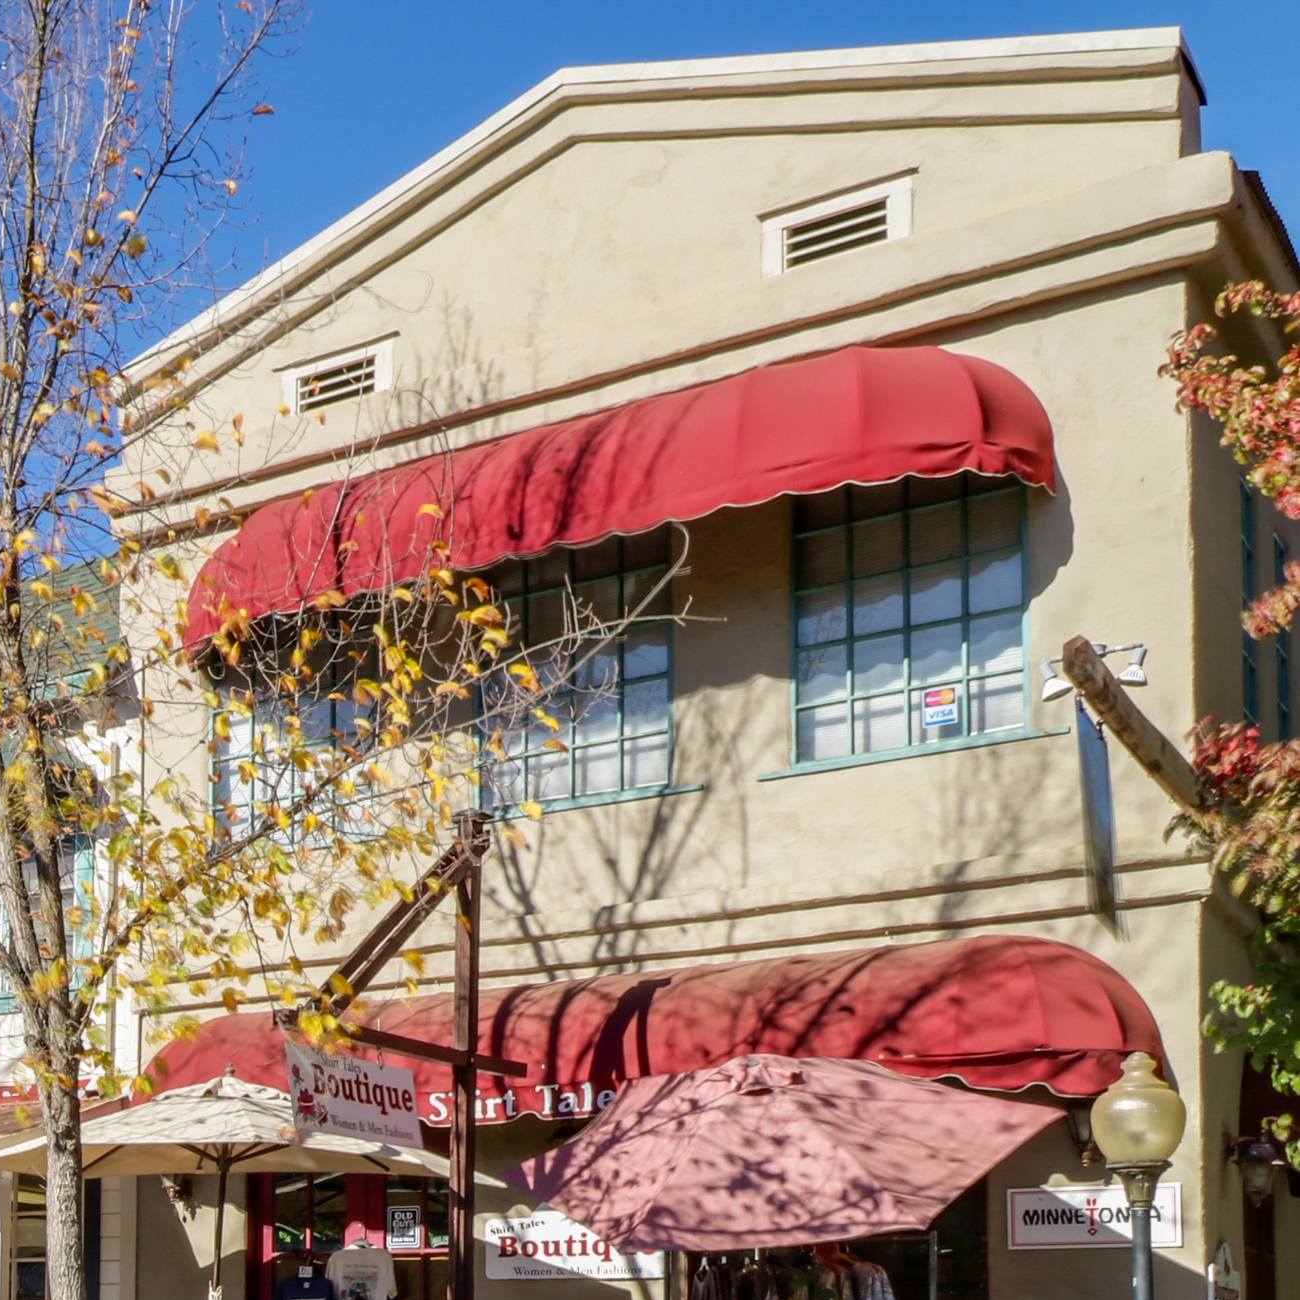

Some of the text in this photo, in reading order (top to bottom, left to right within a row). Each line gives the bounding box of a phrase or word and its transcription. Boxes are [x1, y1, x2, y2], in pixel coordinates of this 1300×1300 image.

[929, 709, 954, 719] VISA
[321, 1054, 362, 1074] Shirt Tales
[312, 1063, 414, 1116] Boutique
[429, 1081, 618, 1121] Sirt Tale
[330, 1114, 414, 1140] Women & Men Fashions
[392, 1219, 415, 1228] GUYS
[394, 1211, 414, 1220] OLD
[1022, 1203, 1162, 1231] MINNETONA
[489, 1219, 546, 1236] Shirt Tales
[497, 1232, 656, 1262] Boutiq
[513, 1265, 642, 1276] Women & Men Fashions
